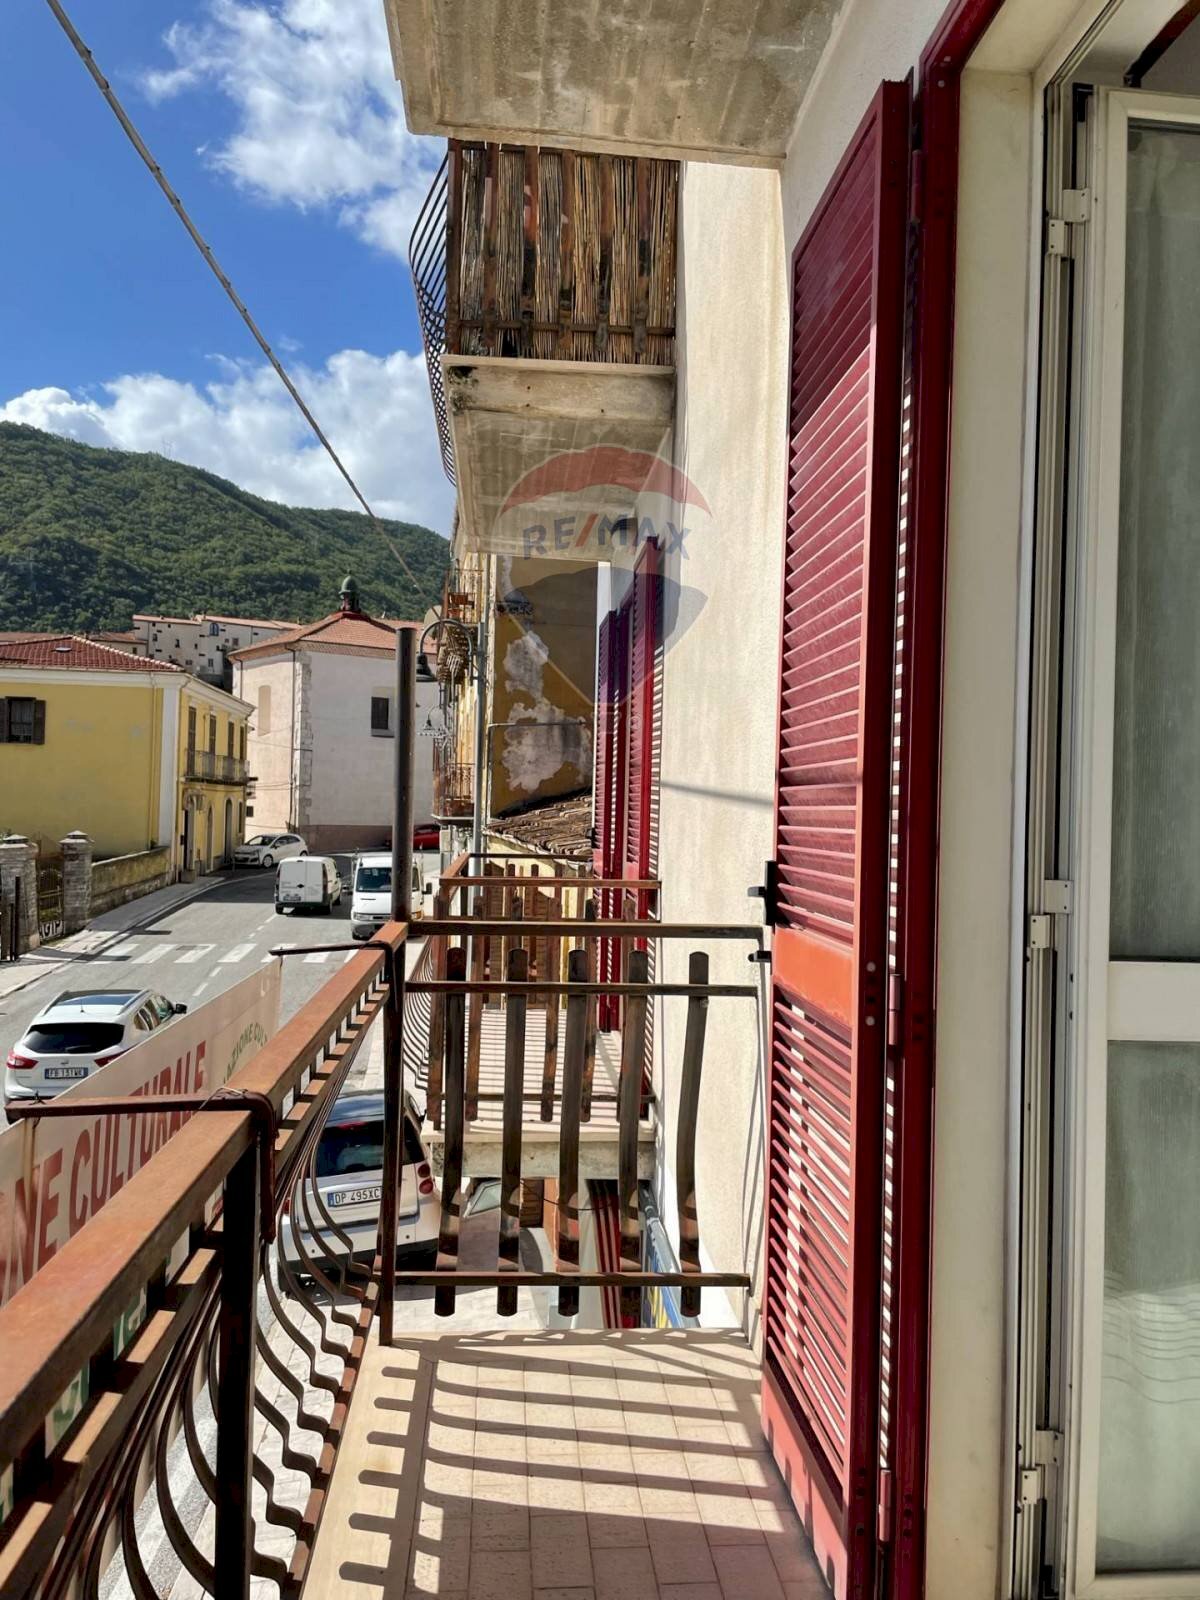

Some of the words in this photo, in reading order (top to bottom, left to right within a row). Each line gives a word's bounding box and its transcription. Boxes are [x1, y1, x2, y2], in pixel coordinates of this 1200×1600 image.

[69, 1040, 206, 1239] CULTURALE
[335, 1192, 346, 1204] DP
[351, 1188, 380, 1201] 495XC
